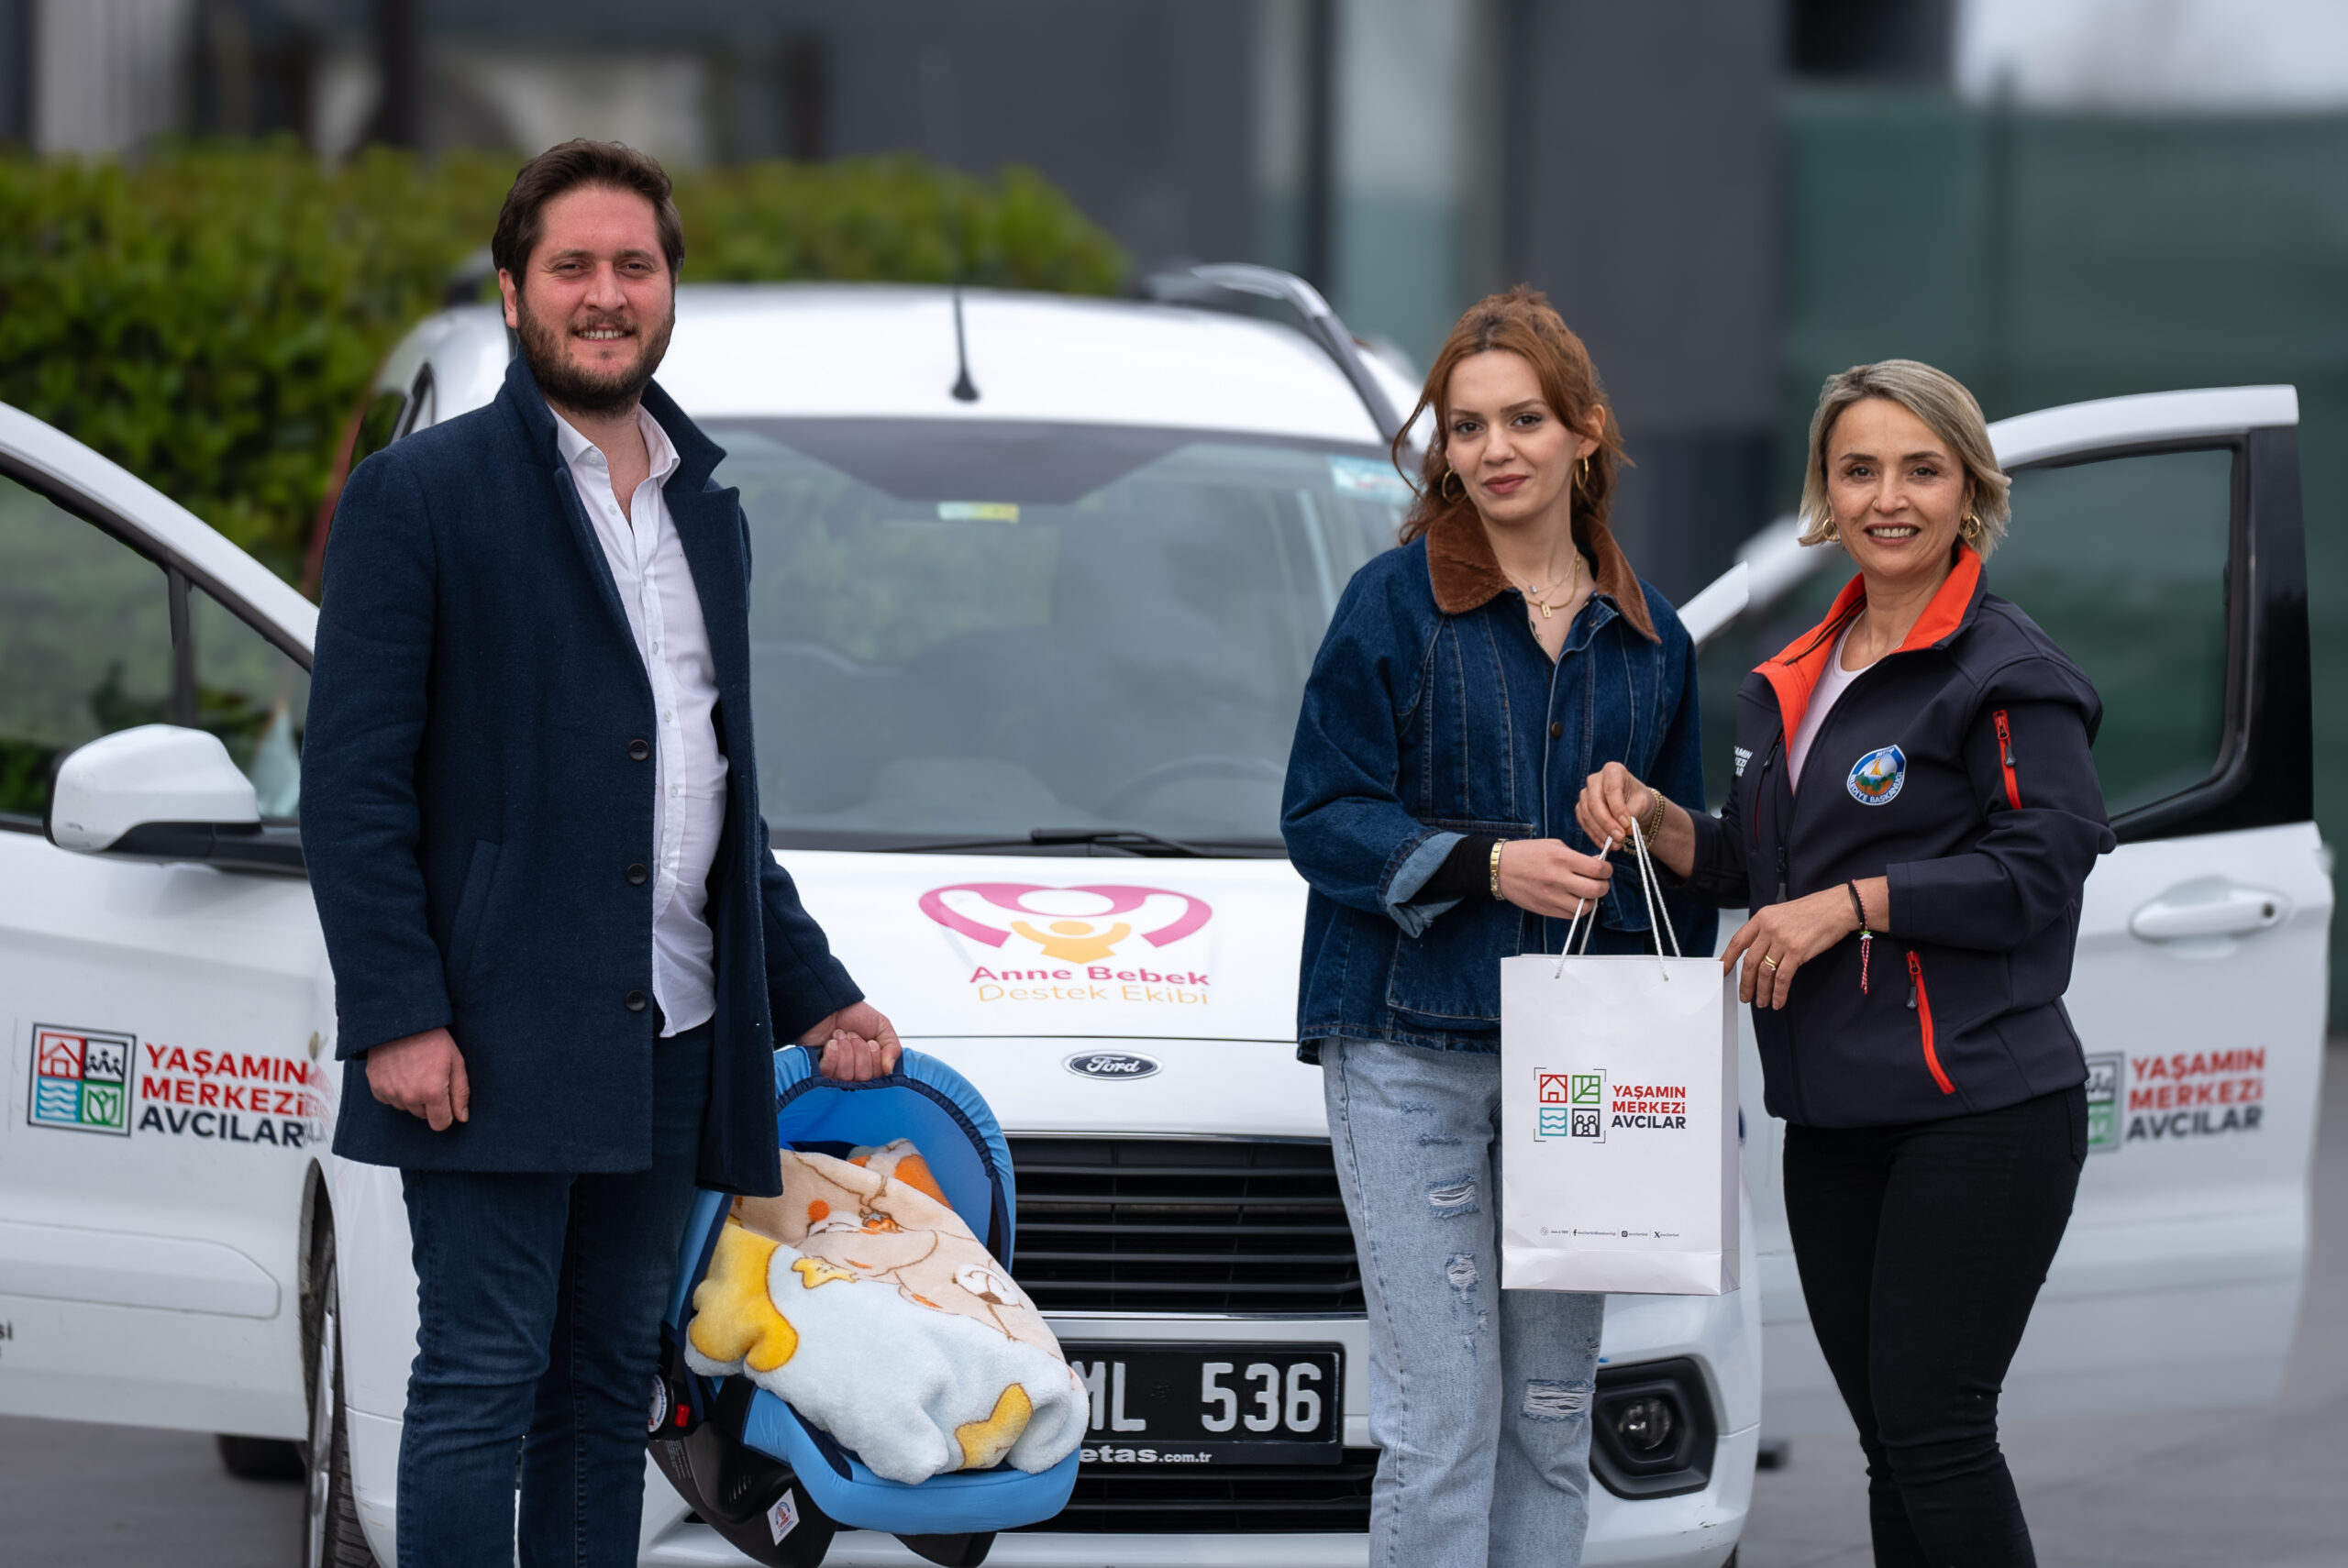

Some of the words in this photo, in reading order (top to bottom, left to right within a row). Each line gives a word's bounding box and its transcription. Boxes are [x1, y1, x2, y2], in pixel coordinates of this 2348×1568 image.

[970, 966, 1072, 983] Anne
[1087, 966, 1211, 986] Bebek
[978, 984, 1108, 1002] Destek
[1122, 985, 1209, 1006] Ekibi
[144, 1042, 309, 1086] YAŞAMIN
[1086, 1055, 1140, 1073] Ford
[2131, 1046, 2265, 1082] YAŞAMIN
[1612, 1085, 1686, 1100] YAŞAMIN
[138, 1104, 305, 1149] AVCILAR
[1611, 1114, 1687, 1130] AVCILAR
[2125, 1105, 2264, 1143] AVCILAR
[1201, 1363, 1322, 1432] 536
[1080, 1445, 1213, 1463] etas.com.tr
